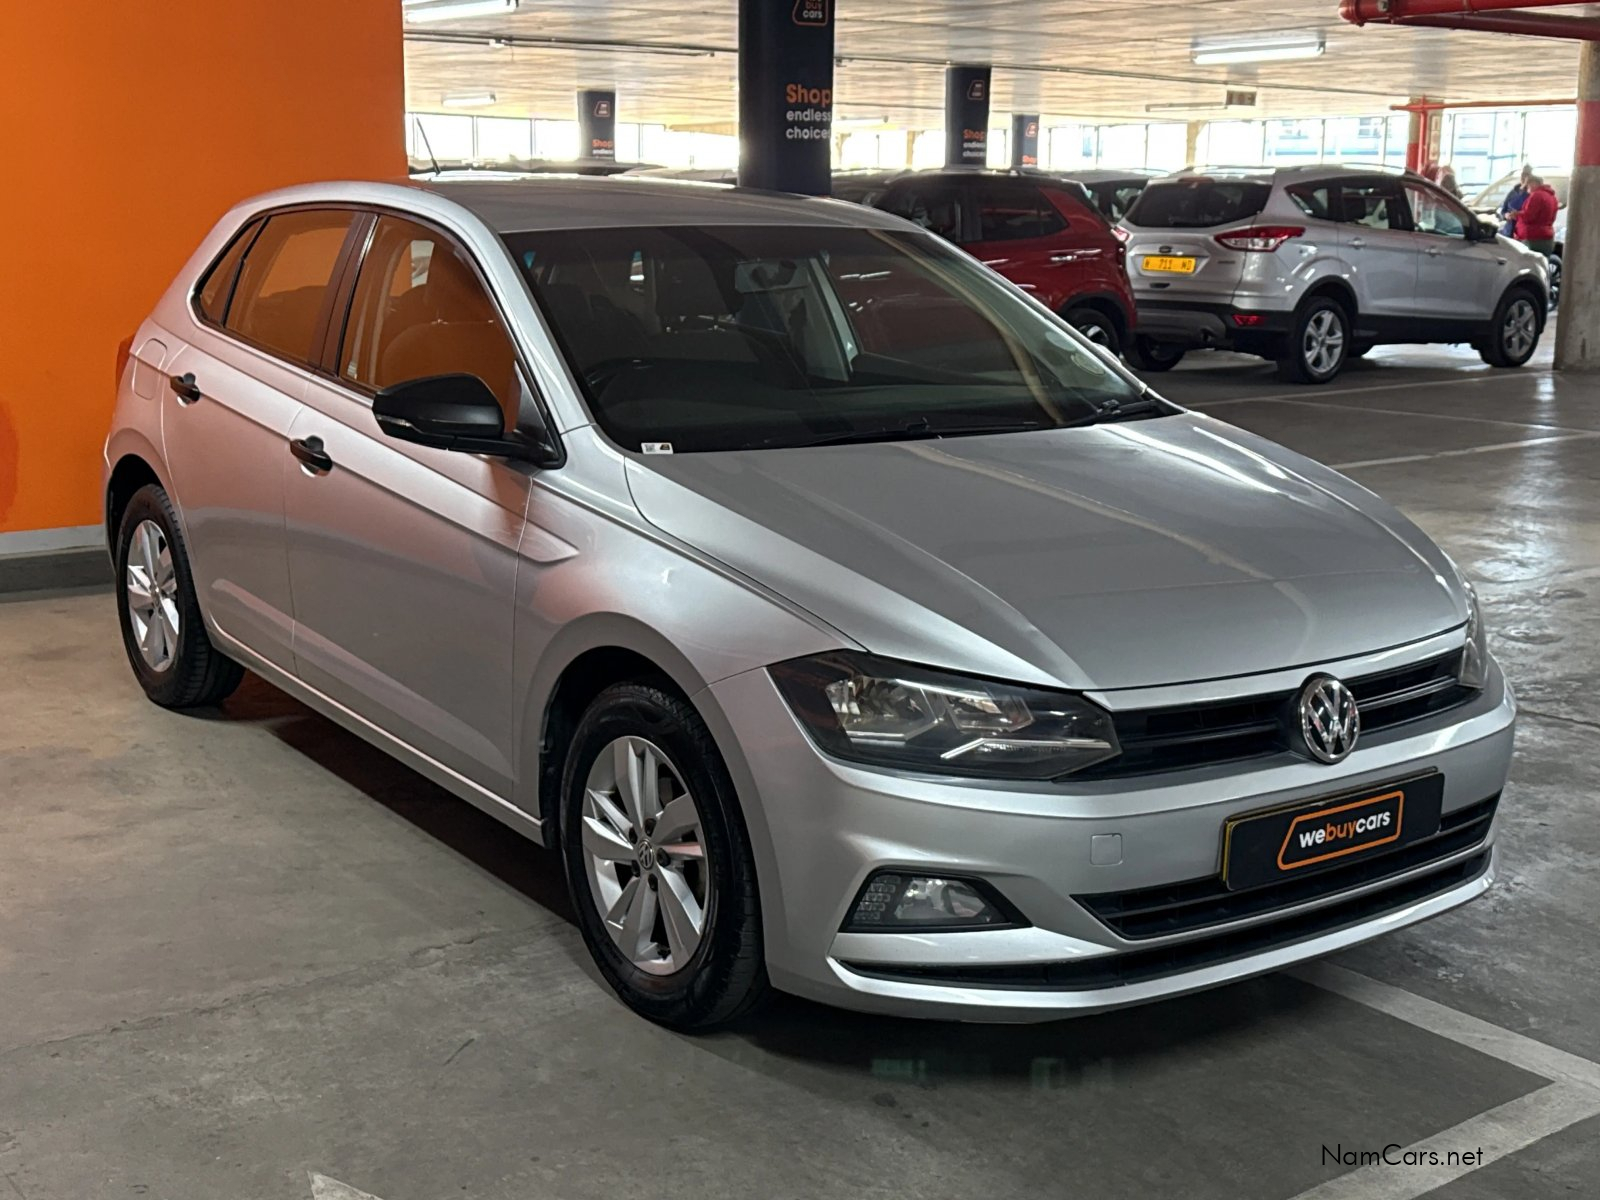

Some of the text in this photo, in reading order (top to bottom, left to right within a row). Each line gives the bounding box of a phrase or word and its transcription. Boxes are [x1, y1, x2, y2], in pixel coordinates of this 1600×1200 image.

[802, 10, 823, 18] cars
[786, 84, 831, 107] Shop
[1299, 811, 1391, 848] webuycars
